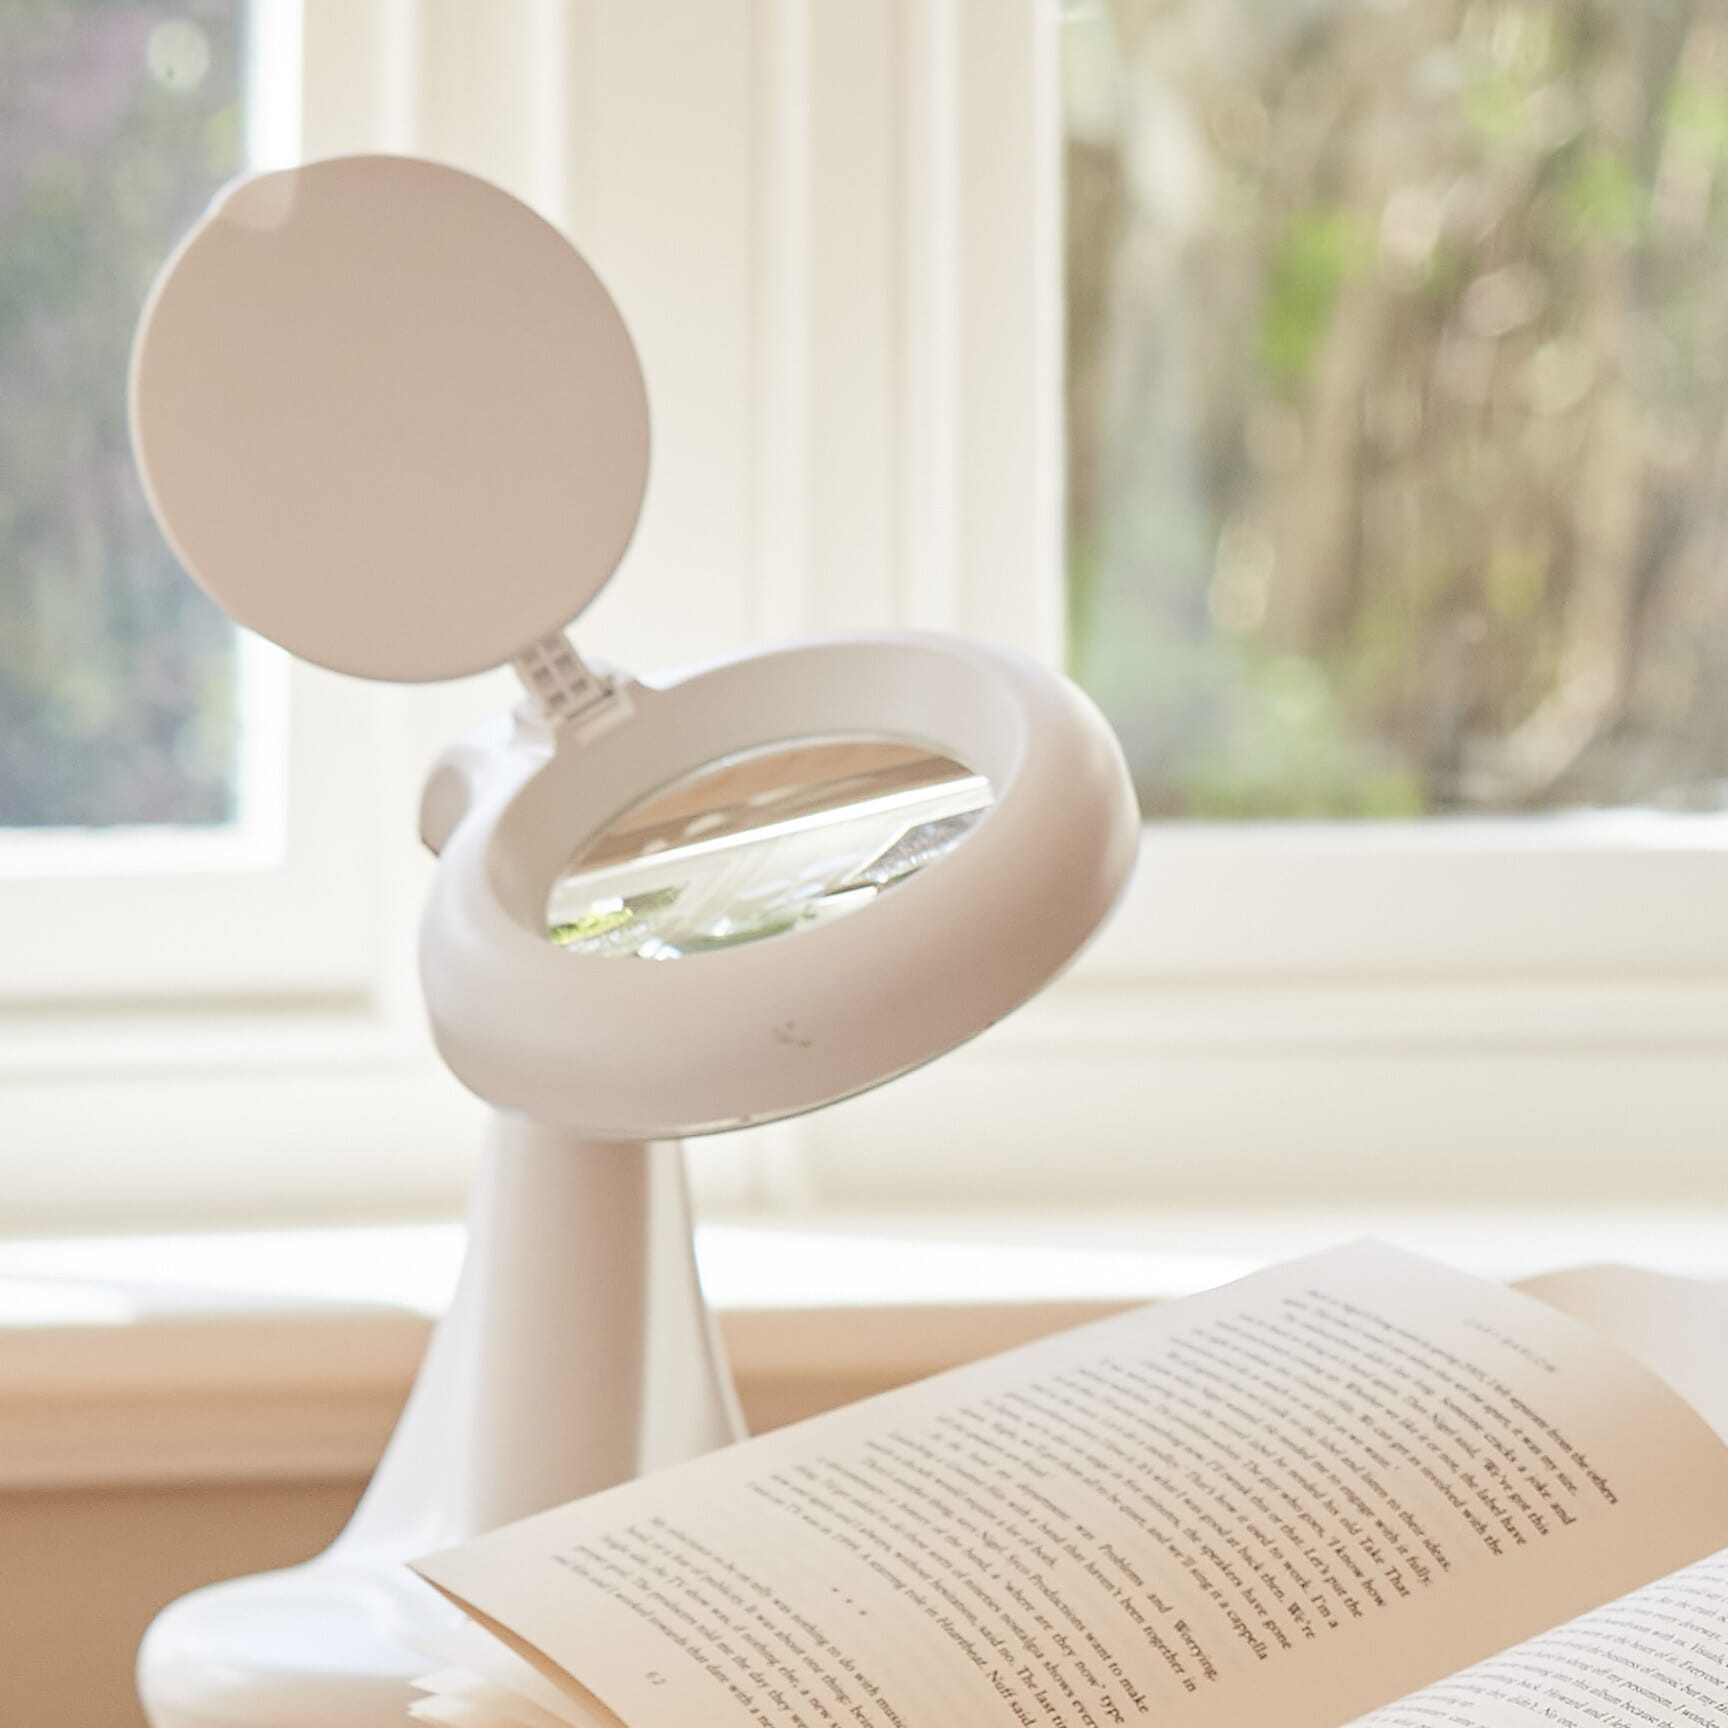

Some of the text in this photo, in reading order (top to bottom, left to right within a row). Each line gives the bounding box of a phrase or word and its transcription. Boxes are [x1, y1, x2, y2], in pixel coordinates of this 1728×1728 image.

[1522, 1436, 1541, 1454] was
[1547, 1429, 1617, 1504] from the others
[1460, 1473, 1526, 1544] the label have
[1508, 1493, 1548, 1535] got this
[1550, 1503, 1576, 1524] and
[1375, 1519, 1398, 1543] with
[1399, 1511, 1450, 1571] their ideas.
[1462, 1509, 1502, 1555] with the
[1283, 1561, 1310, 1592] work.
[1335, 1546, 1385, 1606] know how
[1340, 1518, 1410, 1596] old Take That
[1147, 1593, 1172, 1613] and
[1260, 1573, 1284, 1601] then.
[1323, 1576, 1362, 1617] put the
[1227, 1610, 1266, 1659] cappella
[1242, 1588, 1291, 1648] have gone
[1143, 1626, 1184, 1672] together
[854, 1673, 878, 1695] with
[1017, 1665, 1036, 1688] The
[1035, 1690, 1055, 1713] last
[1043, 1661, 1073, 1697] shows
[1085, 1632, 1111, 1660] want
[1120, 1678, 1148, 1712] make
[1100, 1695, 1124, 1723] type
